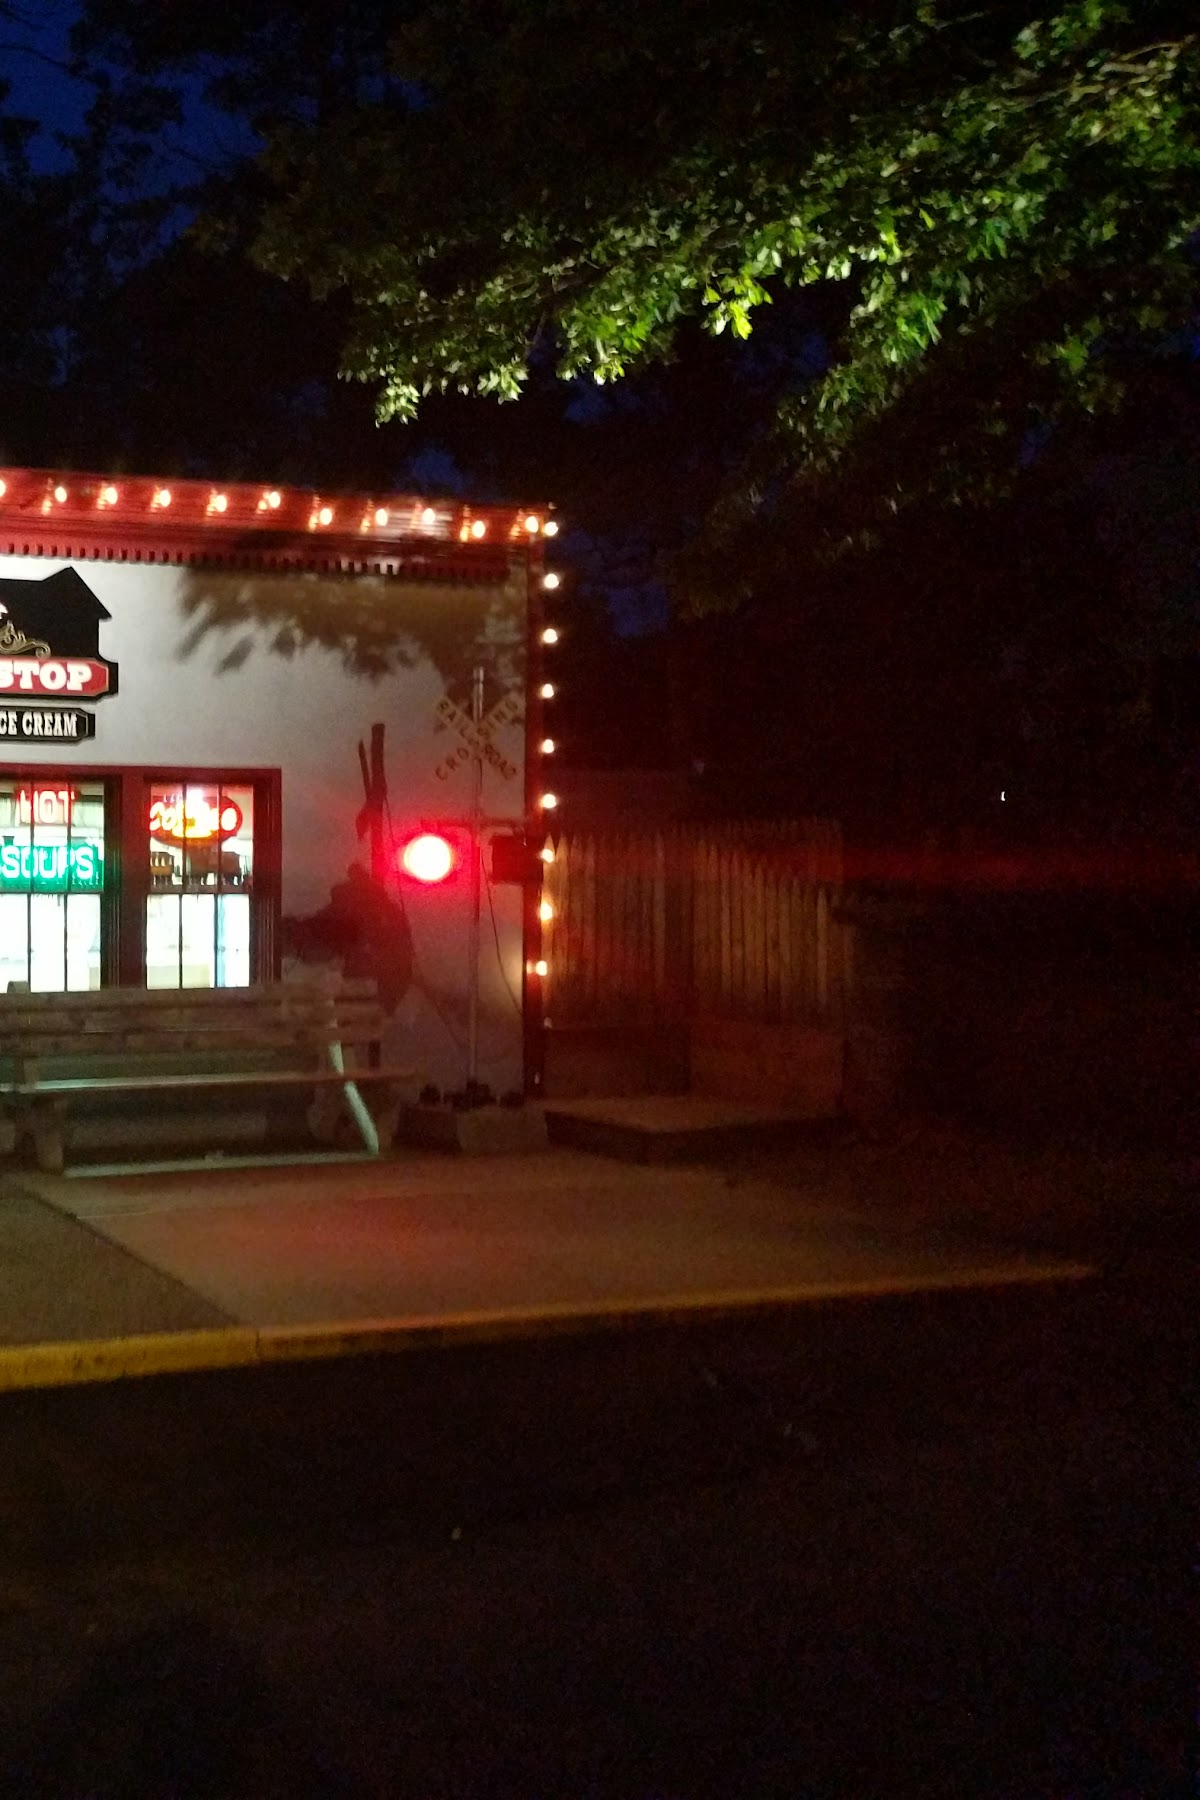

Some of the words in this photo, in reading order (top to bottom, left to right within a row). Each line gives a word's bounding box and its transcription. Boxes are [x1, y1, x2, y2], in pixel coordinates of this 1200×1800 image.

[22, 711, 78, 737] CREAM
[20, 789, 75, 824] HOT
[2, 845, 94, 880] SOUPS
